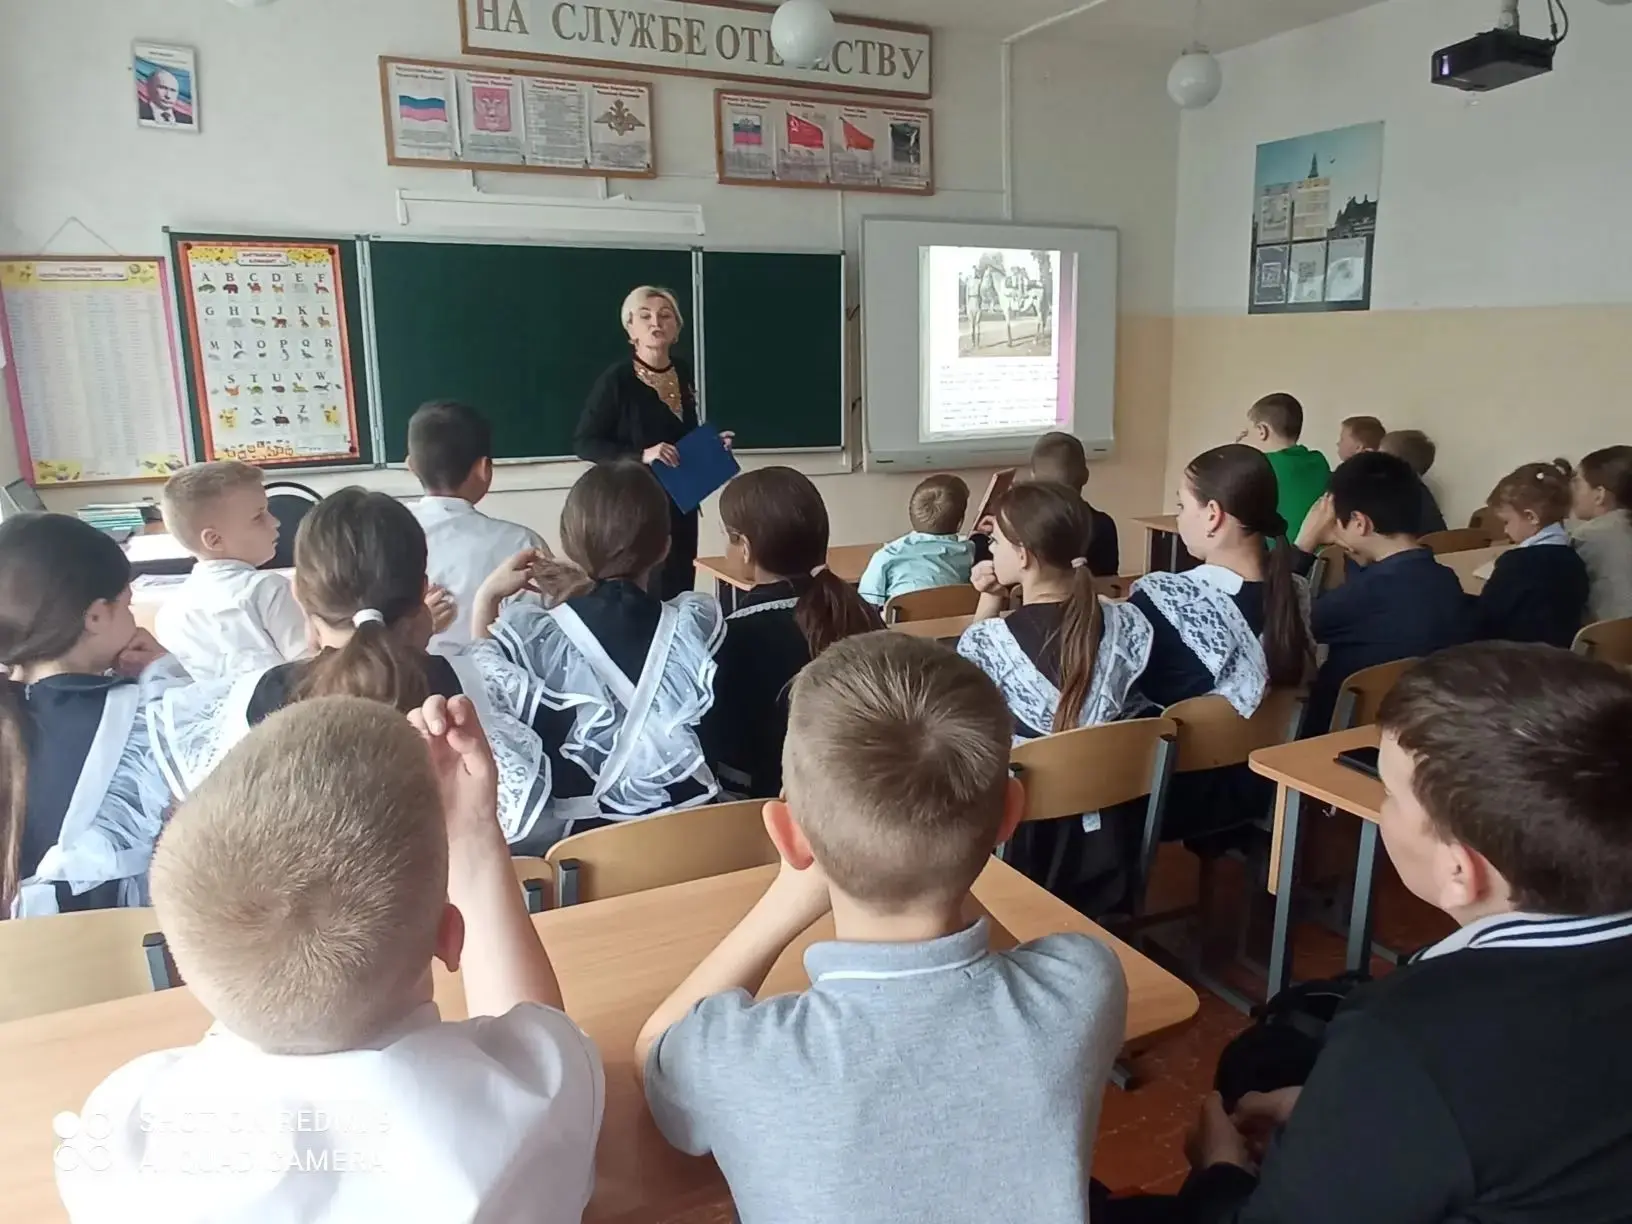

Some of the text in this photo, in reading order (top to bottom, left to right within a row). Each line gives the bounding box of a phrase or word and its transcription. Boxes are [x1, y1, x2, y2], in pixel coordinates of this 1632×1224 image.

[474, 0, 924, 80] НА СЛУЖБЕ ОТЕСТВУ
[202, 273, 325, 282] A B C D E F
[205, 306, 329, 316] G H I J K L
[233, 340, 243, 349] N
[257, 340, 266, 349] O
[280, 339, 288, 348] P
[302, 339, 310, 348] Q
[324, 339, 333, 348] R
[227, 371, 326, 384] S T U V W
[253, 405, 306, 416] X Y Z
